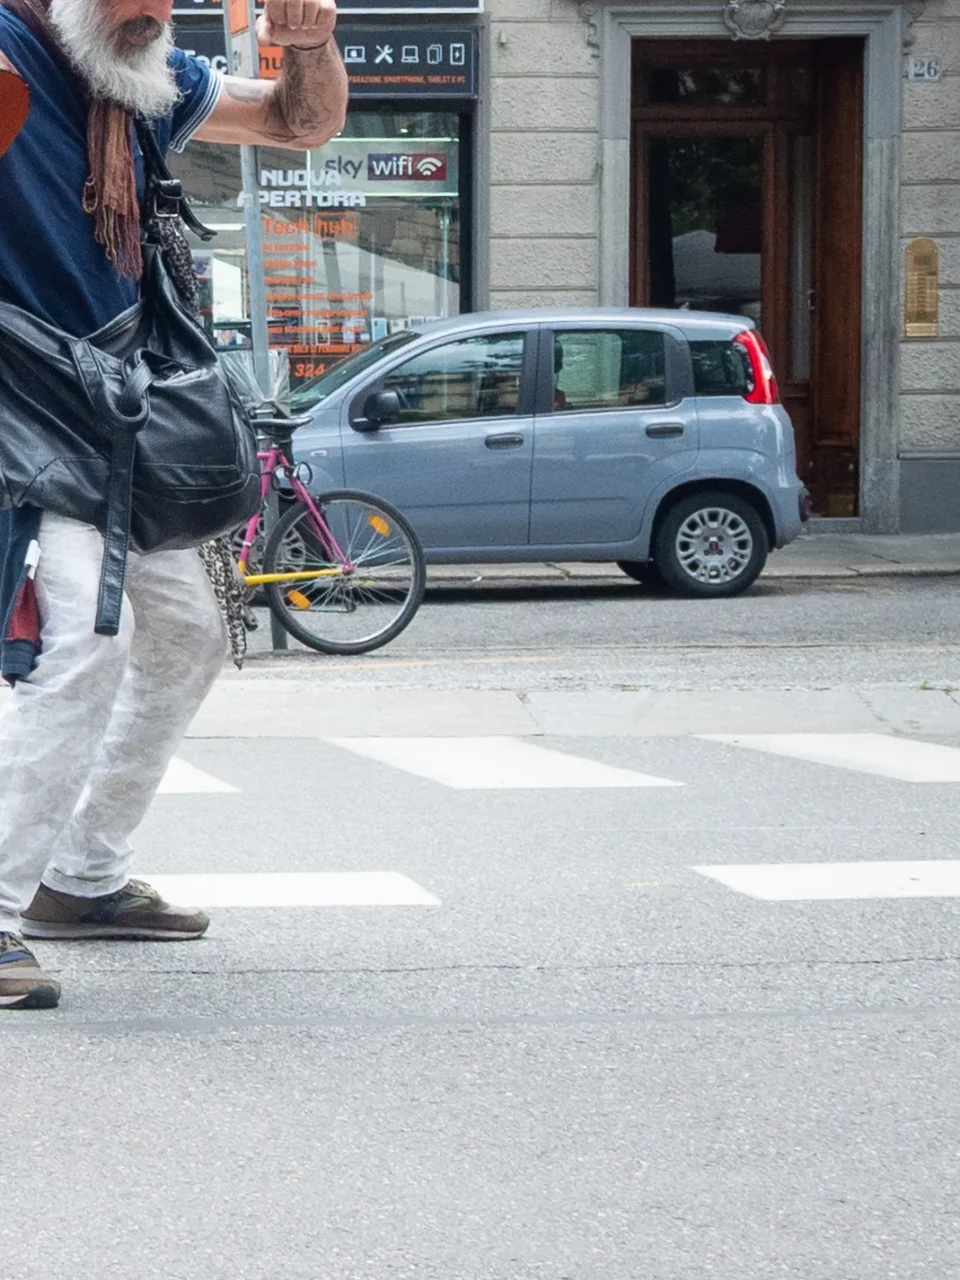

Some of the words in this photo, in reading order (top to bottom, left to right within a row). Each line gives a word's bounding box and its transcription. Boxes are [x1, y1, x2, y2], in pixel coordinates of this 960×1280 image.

[914, 59, 938, 78] 26
[325, 156, 363, 179] sky
[373, 156, 413, 176] wifi
[261, 170, 341, 186] NUOVA
[262, 217, 310, 235] Tech
[316, 217, 354, 233] hub
